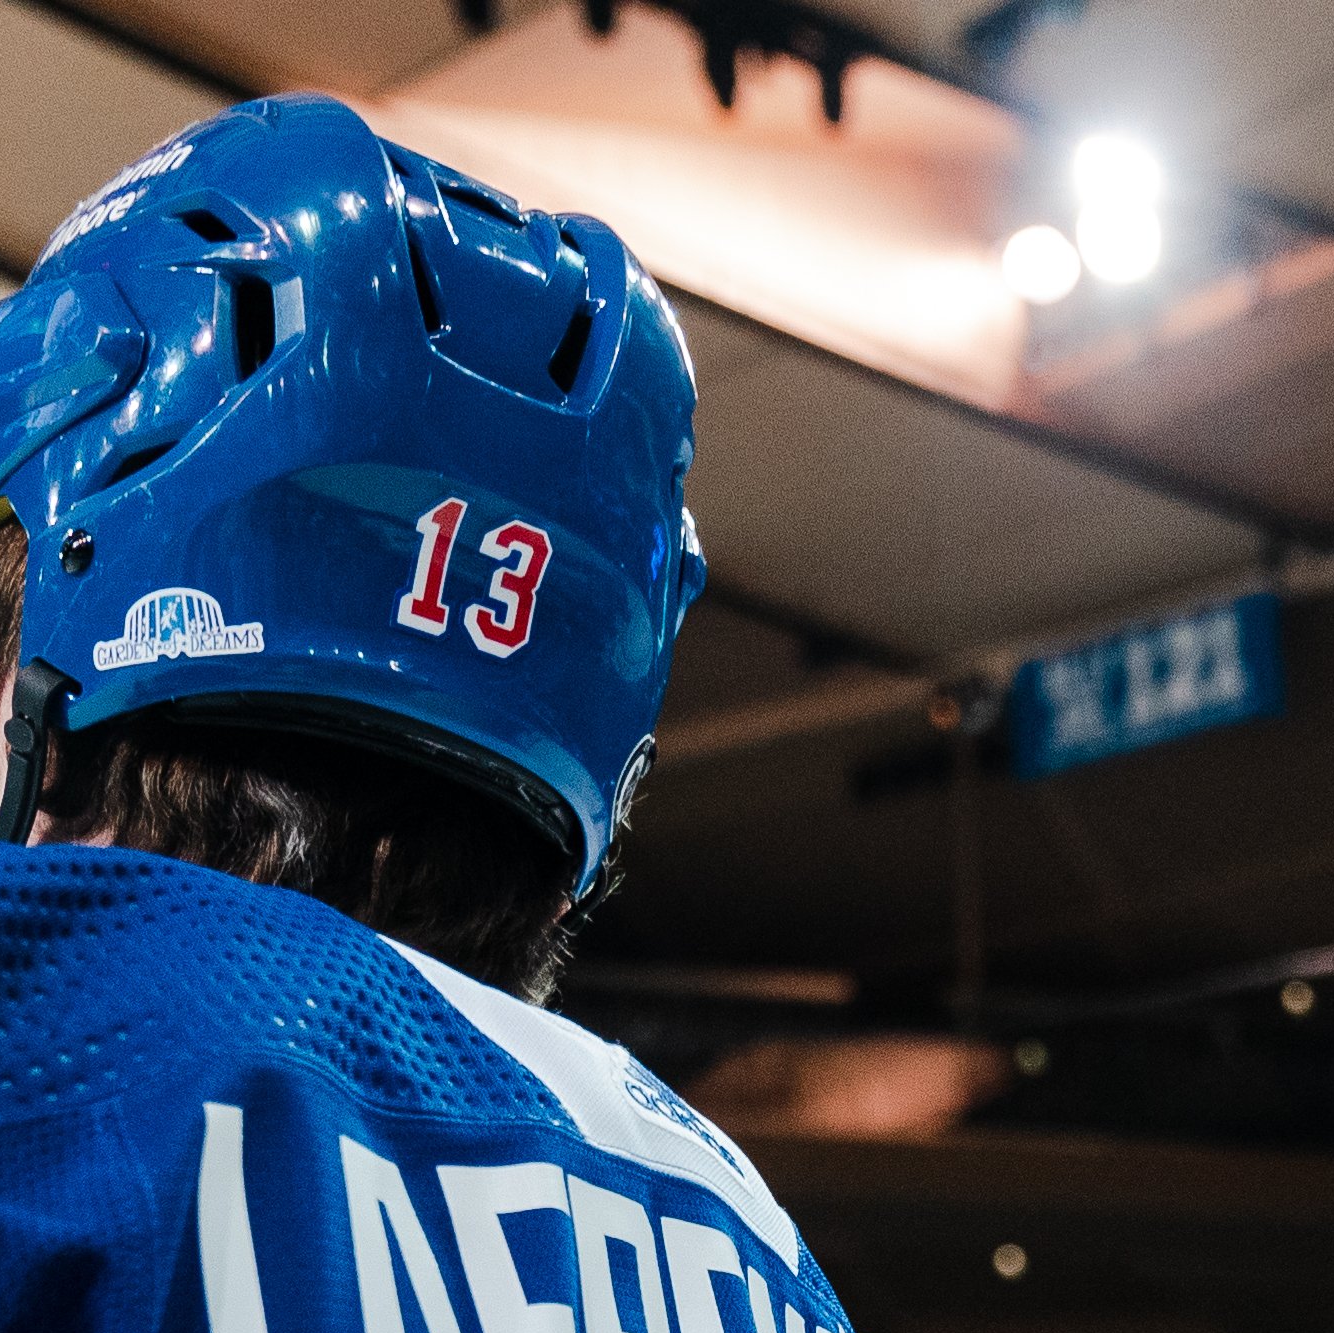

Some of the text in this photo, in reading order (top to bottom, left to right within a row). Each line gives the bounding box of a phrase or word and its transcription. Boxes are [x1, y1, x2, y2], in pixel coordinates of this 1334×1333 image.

[397, 497, 553, 659] 13
[97, 640, 155, 667] GARDEN
[190, 627, 260, 651] DREAMS
